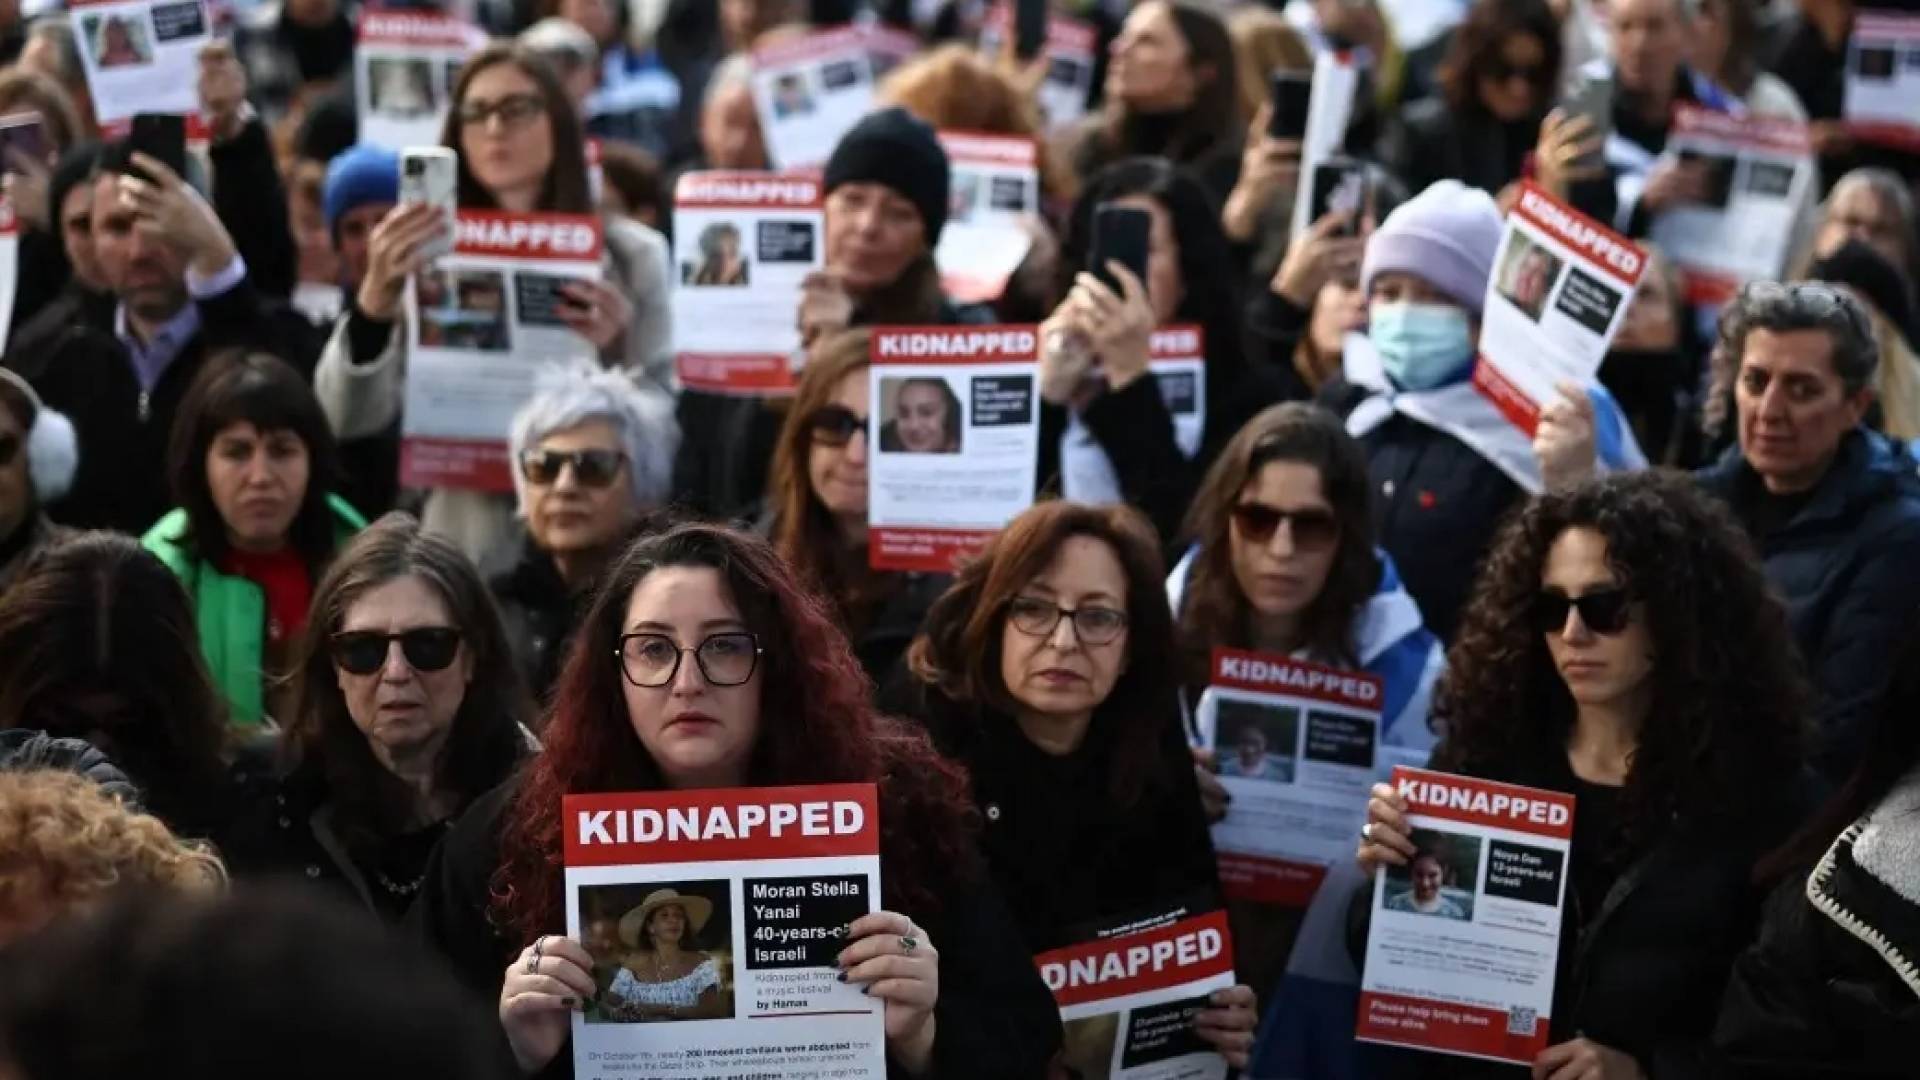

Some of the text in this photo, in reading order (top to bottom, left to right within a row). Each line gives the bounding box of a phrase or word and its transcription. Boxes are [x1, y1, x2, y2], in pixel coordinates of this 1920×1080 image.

[1520, 189, 1640, 272] KIDNAPPED
[879, 331, 1034, 357] KIDNAPPED
[1220, 656, 1377, 700] KIDNAPPED
[1398, 777, 1569, 826] KIDNAPPED
[578, 801, 866, 845] KIDNAPPED
[752, 881, 860, 899] Moran Stella
[753, 904, 801, 919] Yanai
[754, 946, 806, 962] Israeli
[756, 999, 808, 1011] by Hamas
